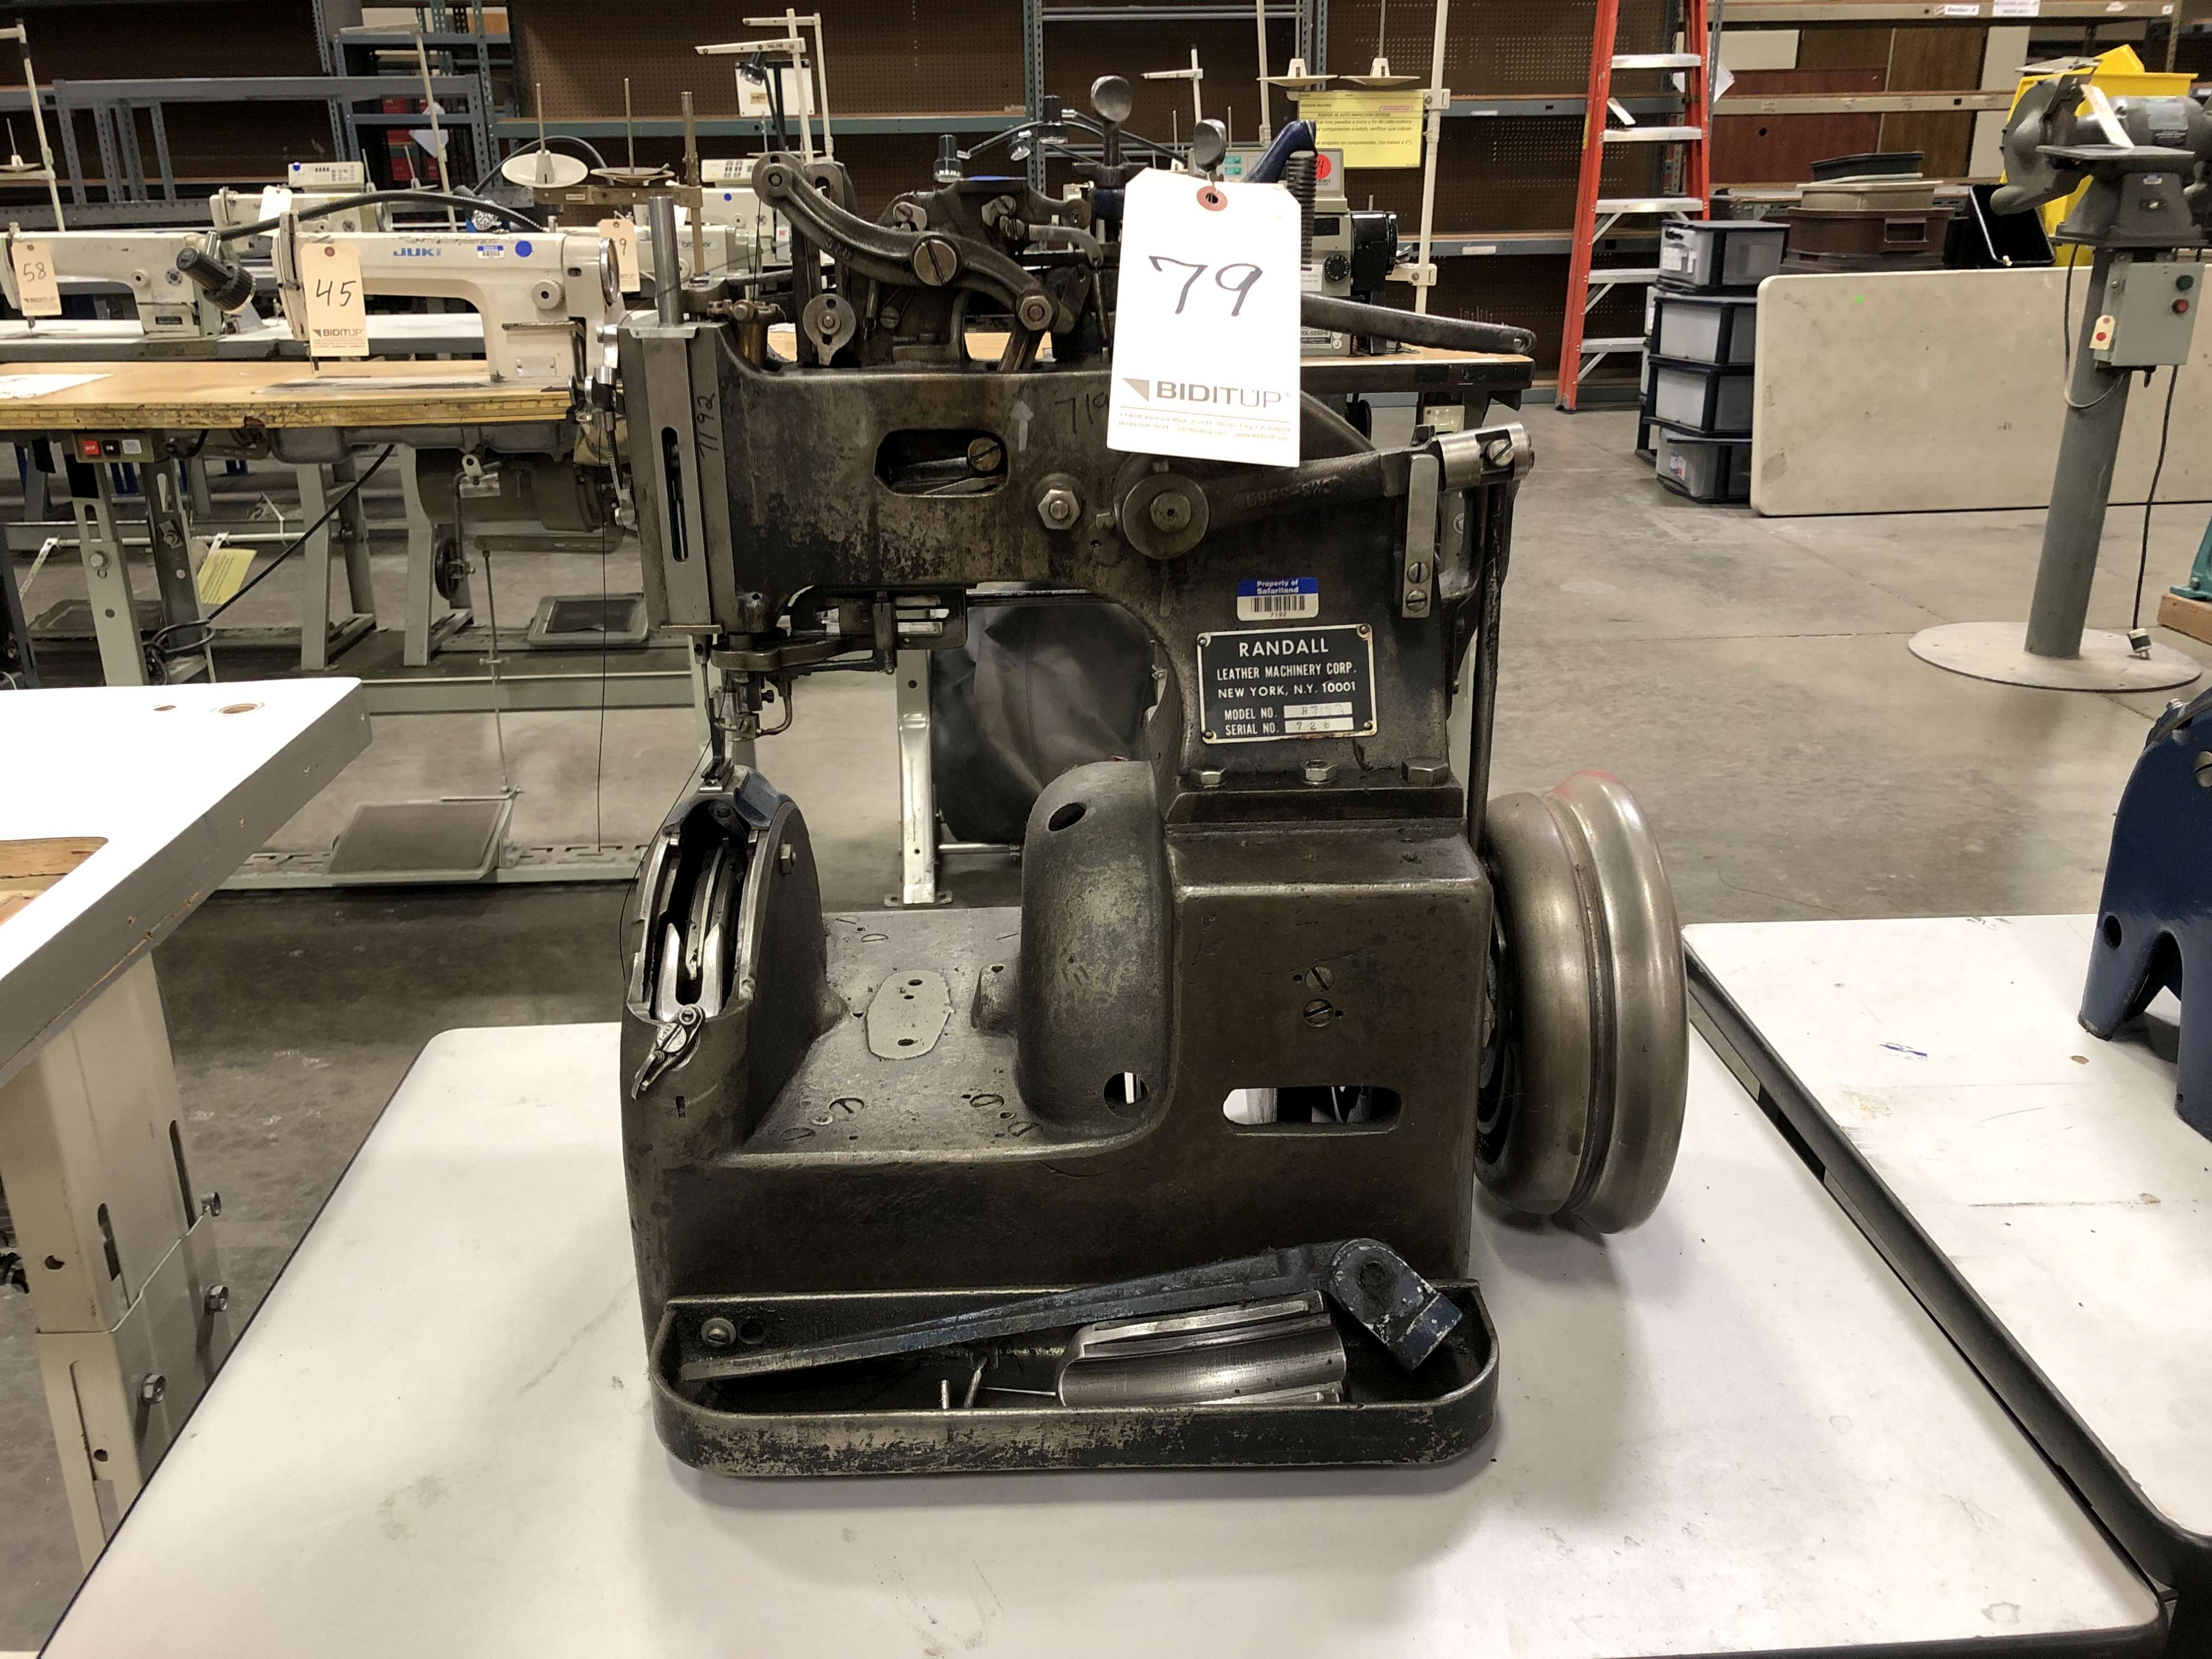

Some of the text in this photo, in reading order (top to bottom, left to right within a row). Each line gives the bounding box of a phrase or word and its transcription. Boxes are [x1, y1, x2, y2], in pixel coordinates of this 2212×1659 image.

[393, 247, 441, 257] JUKI
[23, 262, 46, 283] 58
[316, 278, 357, 306] 45
[1148, 255, 1264, 317] 79
[322, 328, 362, 337] BIDITUP
[1156, 380, 1282, 408] BIDITUP
[1054, 390, 1110, 434] 719
[697, 393, 719, 460] 7192
[1256, 586, 1299, 594] Safariland
[1239, 637, 1329, 658] RANDALL
[1217, 661, 1357, 681] LEATHER MACHINERY CORP.
[1218, 681, 1356, 698] NEW YORK, N.Y. 10001
[1224, 707, 1256, 721] MODEL
[1261, 707, 1278, 718] NO.
[1225, 722, 1258, 736] SERIAL
[1262, 722, 1280, 734] NO.
